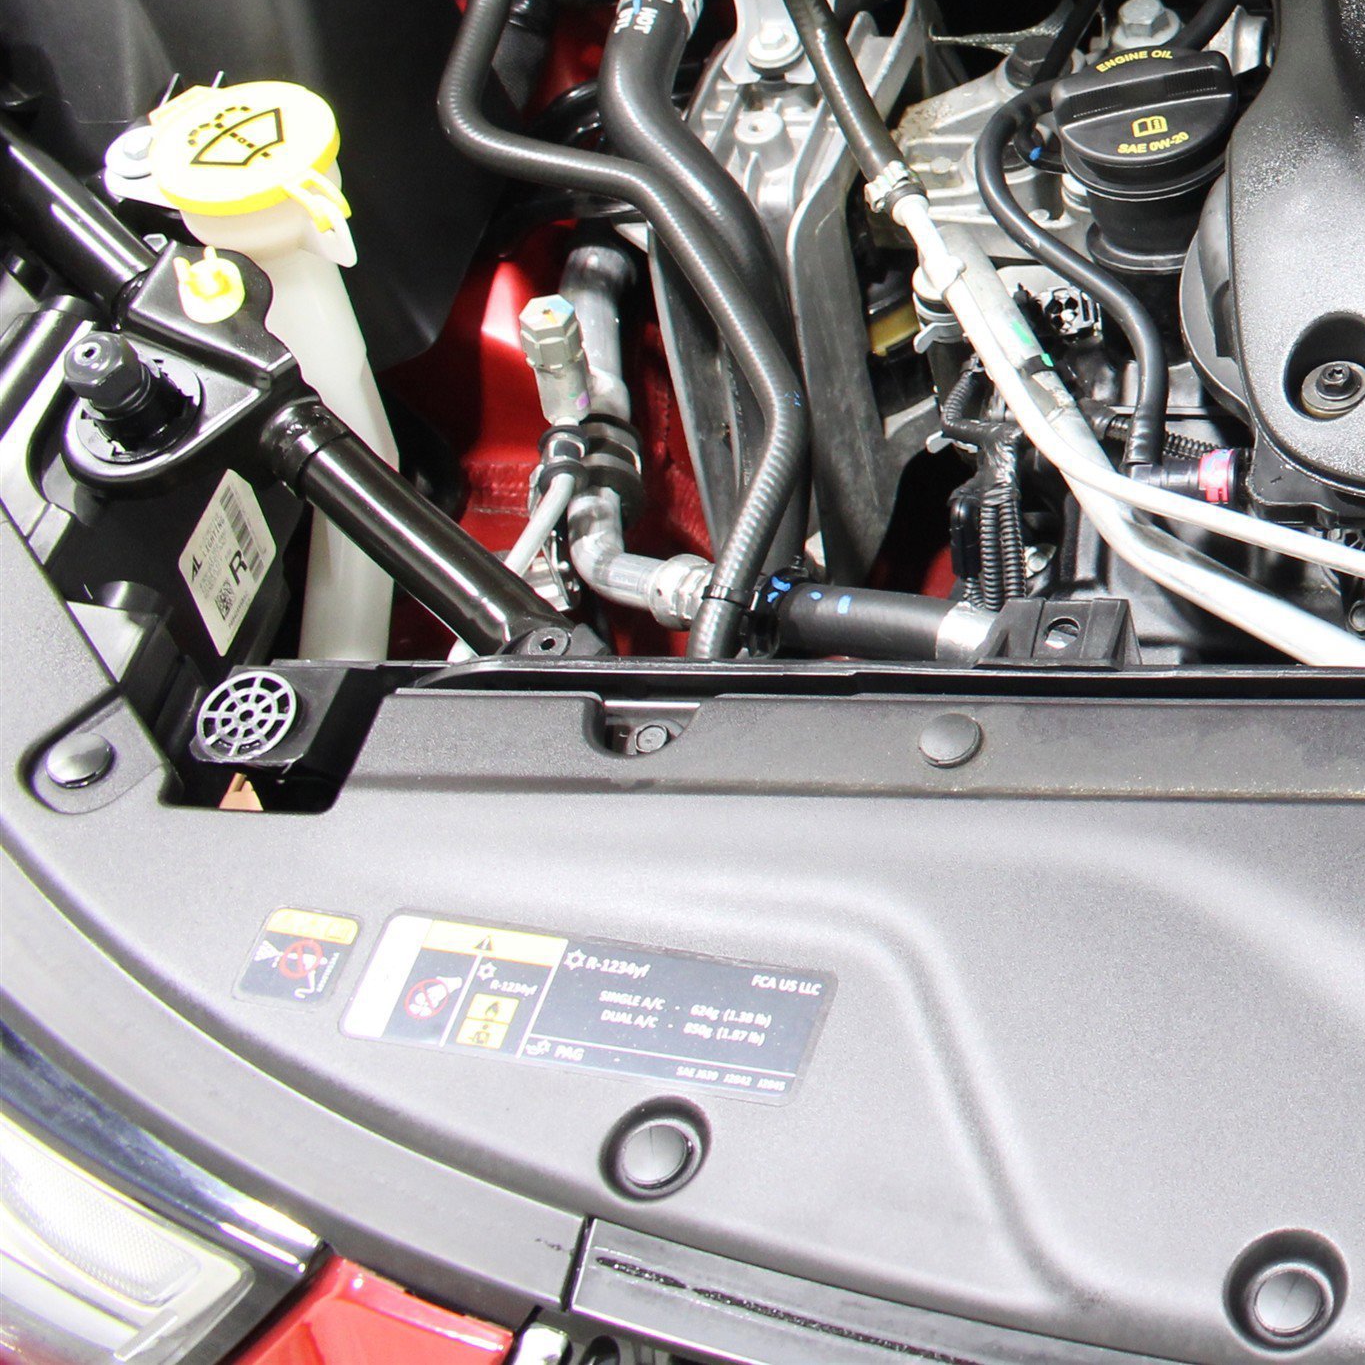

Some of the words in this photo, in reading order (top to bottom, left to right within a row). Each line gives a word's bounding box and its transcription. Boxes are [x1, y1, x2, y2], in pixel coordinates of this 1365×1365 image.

[1096, 50, 1148, 73] ENGINE
[1150, 49, 1174, 59] OIL
[1117, 142, 1148, 154] SAE
[1148, 131, 1190, 152] 0W-20
[229, 549, 248, 587] R
[586, 956, 650, 979] R-1234yf
[752, 975, 777, 989] FCA
[778, 978, 798, 992] US
[798, 981, 822, 995] LLC
[599, 991, 642, 1007] SINGLE
[640, 996, 666, 1011] A/C
[600, 1009, 632, 1025] DUAL
[634, 1015, 659, 1028] A/C
[554, 1045, 585, 1061] PAG
